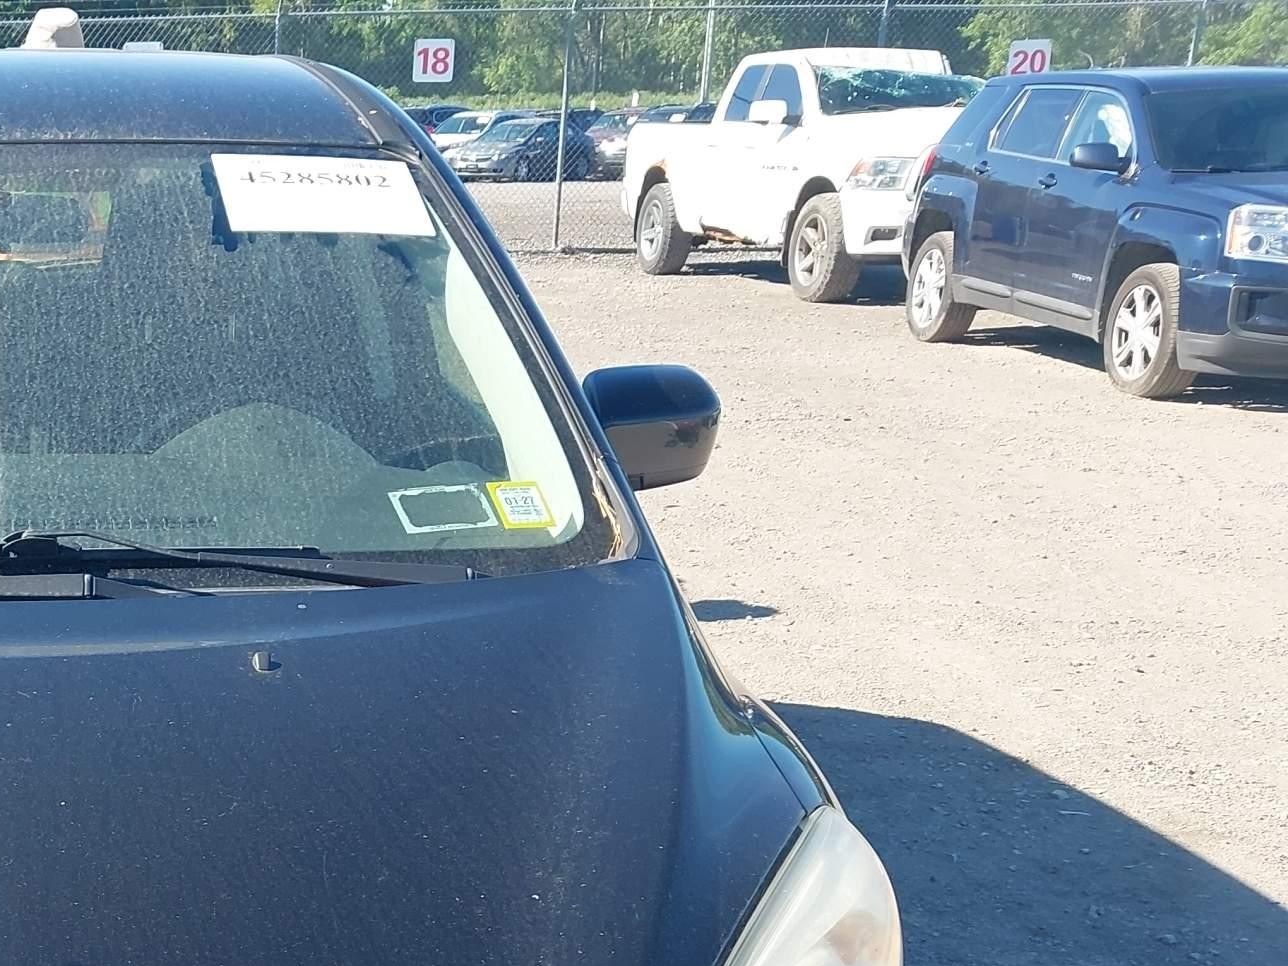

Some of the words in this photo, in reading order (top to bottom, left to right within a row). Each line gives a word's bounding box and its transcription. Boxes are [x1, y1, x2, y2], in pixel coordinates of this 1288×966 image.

[417, 47, 450, 75] 18
[1010, 49, 1046, 75] 20
[240, 170, 391, 188] 45285802
